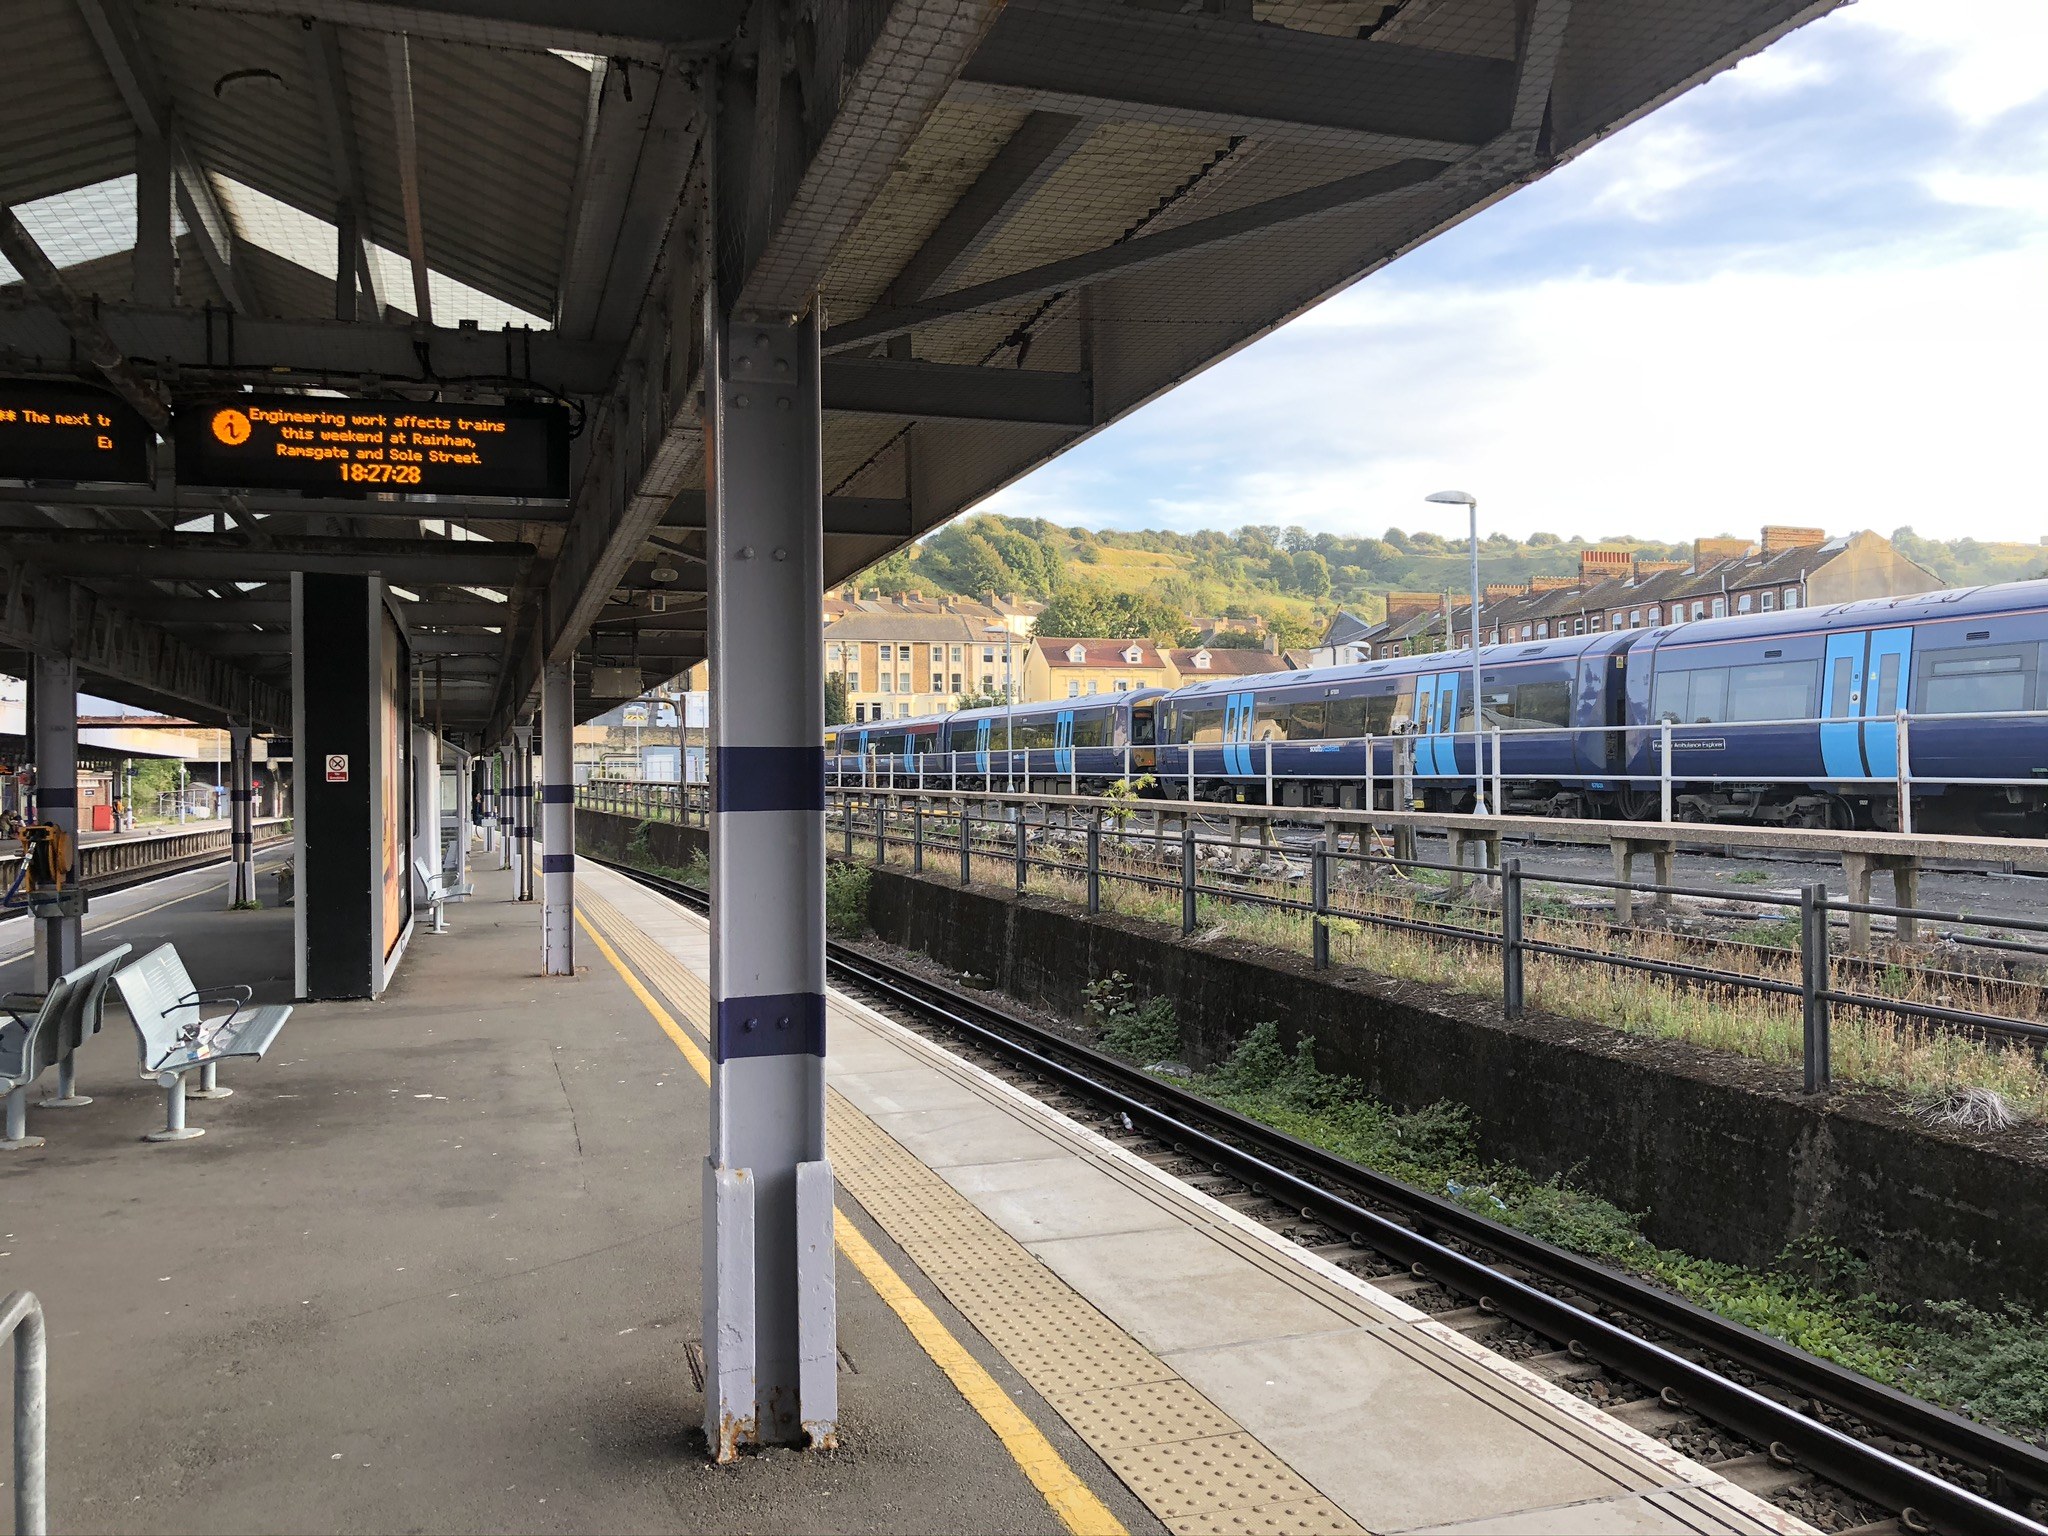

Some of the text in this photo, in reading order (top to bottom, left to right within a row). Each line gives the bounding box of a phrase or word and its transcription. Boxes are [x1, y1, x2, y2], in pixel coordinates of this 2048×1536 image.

[22, 410, 51, 424] The
[55, 412, 92, 426] next
[248, 407, 506, 432] Engineering work affects trains
[281, 426, 476, 449] this weekend at Rainham,
[276, 443, 482, 464] Ramsgate and Sole Street.
[340, 462, 421, 484] 18:27:28
